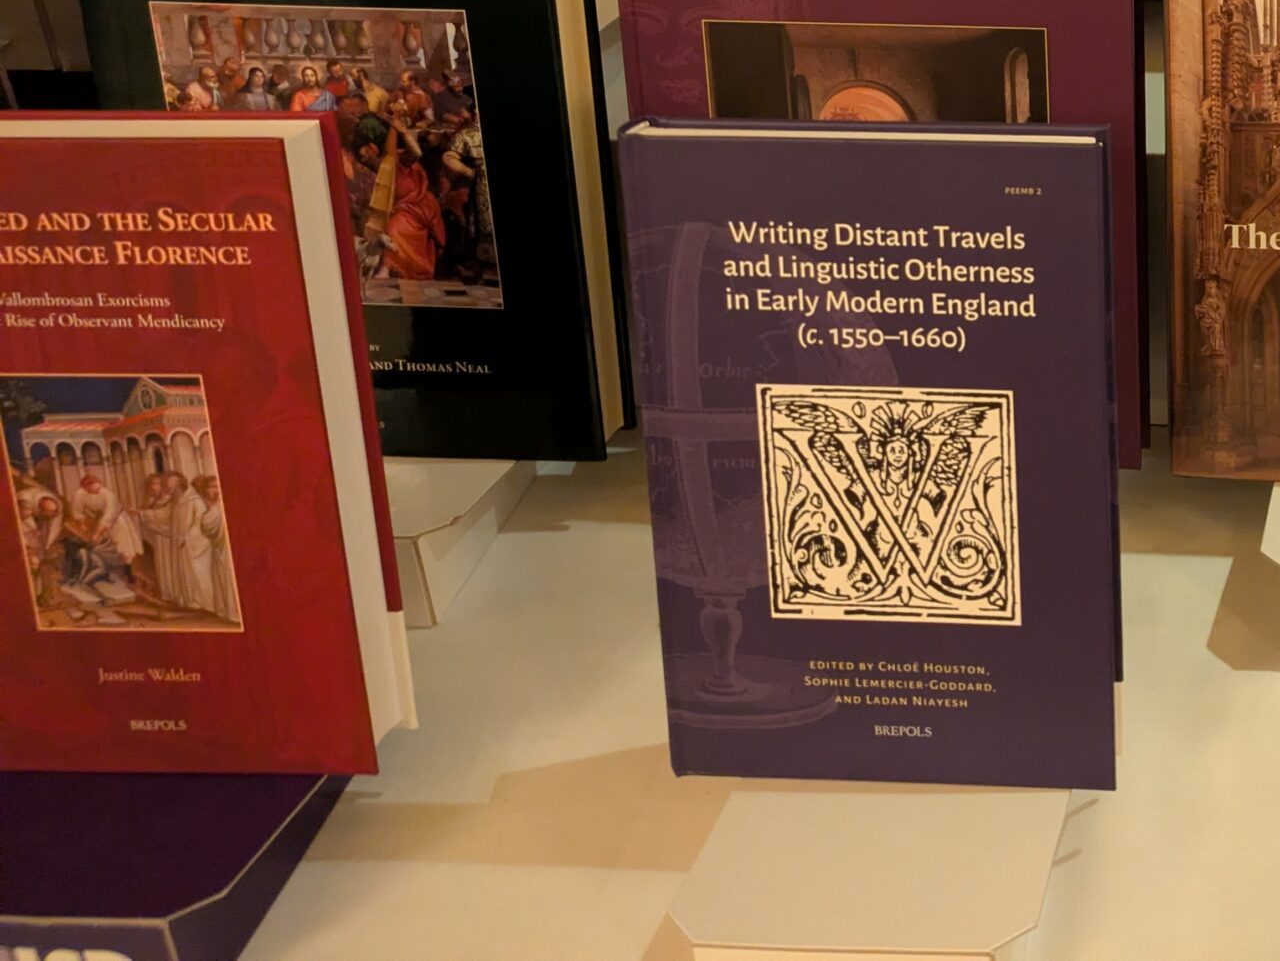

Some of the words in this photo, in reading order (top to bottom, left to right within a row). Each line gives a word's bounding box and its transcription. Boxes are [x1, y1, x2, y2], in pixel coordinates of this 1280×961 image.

[728, 221, 828, 251] Writing
[834, 223, 928, 247] Distant
[933, 225, 1025, 249] Travels
[724, 254, 772, 277] and
[778, 255, 900, 284] Linguistic
[905, 257, 1034, 283] Otherness
[726, 287, 749, 310] in
[756, 288, 819, 317] Early
[826, 290, 924, 314] Modern
[932, 293, 1036, 321] England
[98, 667, 144, 683] Justine
[147, 668, 201, 681] Walden
[874, 725, 932, 737] BREPOLS
